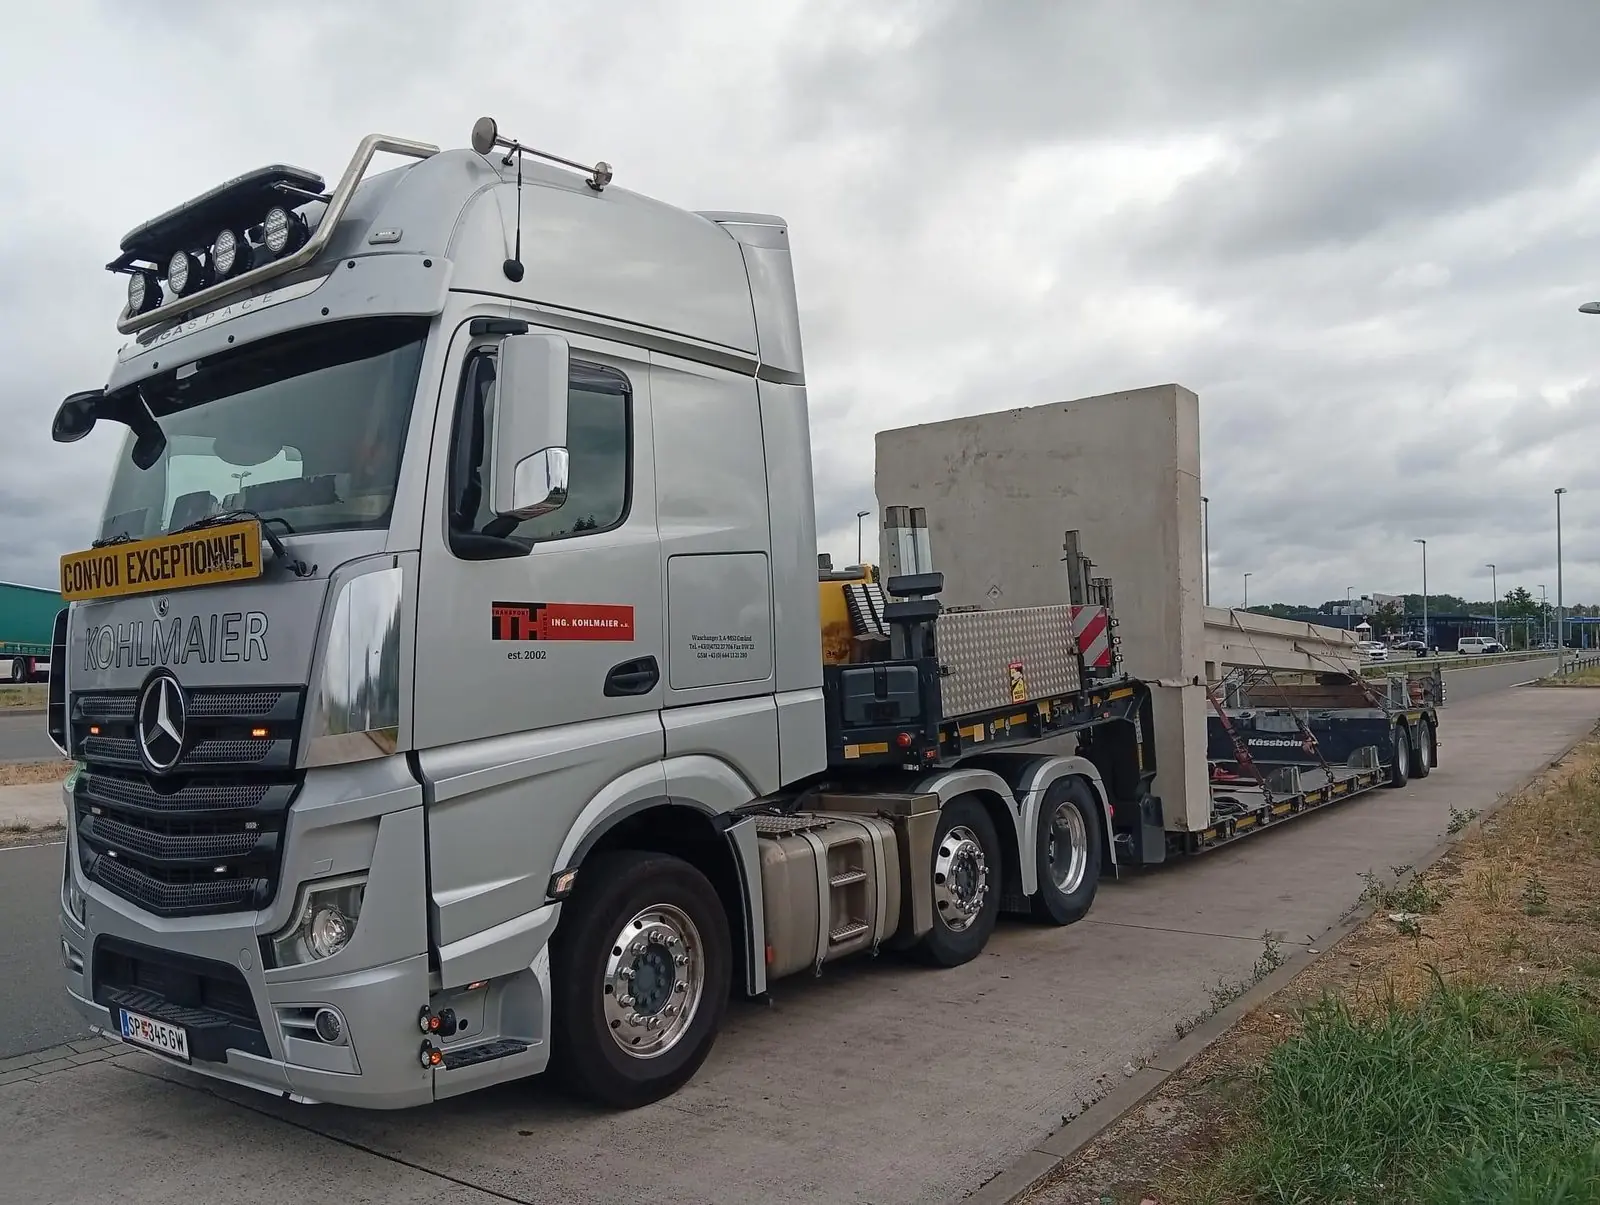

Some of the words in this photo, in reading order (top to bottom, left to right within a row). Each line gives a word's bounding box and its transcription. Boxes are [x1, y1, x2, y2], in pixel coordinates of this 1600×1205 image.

[63, 554, 120, 593] CONVOI
[126, 532, 253, 585] EXCEPTIONNEL
[551, 618, 570, 627] ING.
[572, 618, 619, 628] KOHLMAIER
[84, 611, 269, 671] KOHLMAIER
[524, 650, 547, 660] 2002
[1248, 738, 1303, 747] Kässbohr
